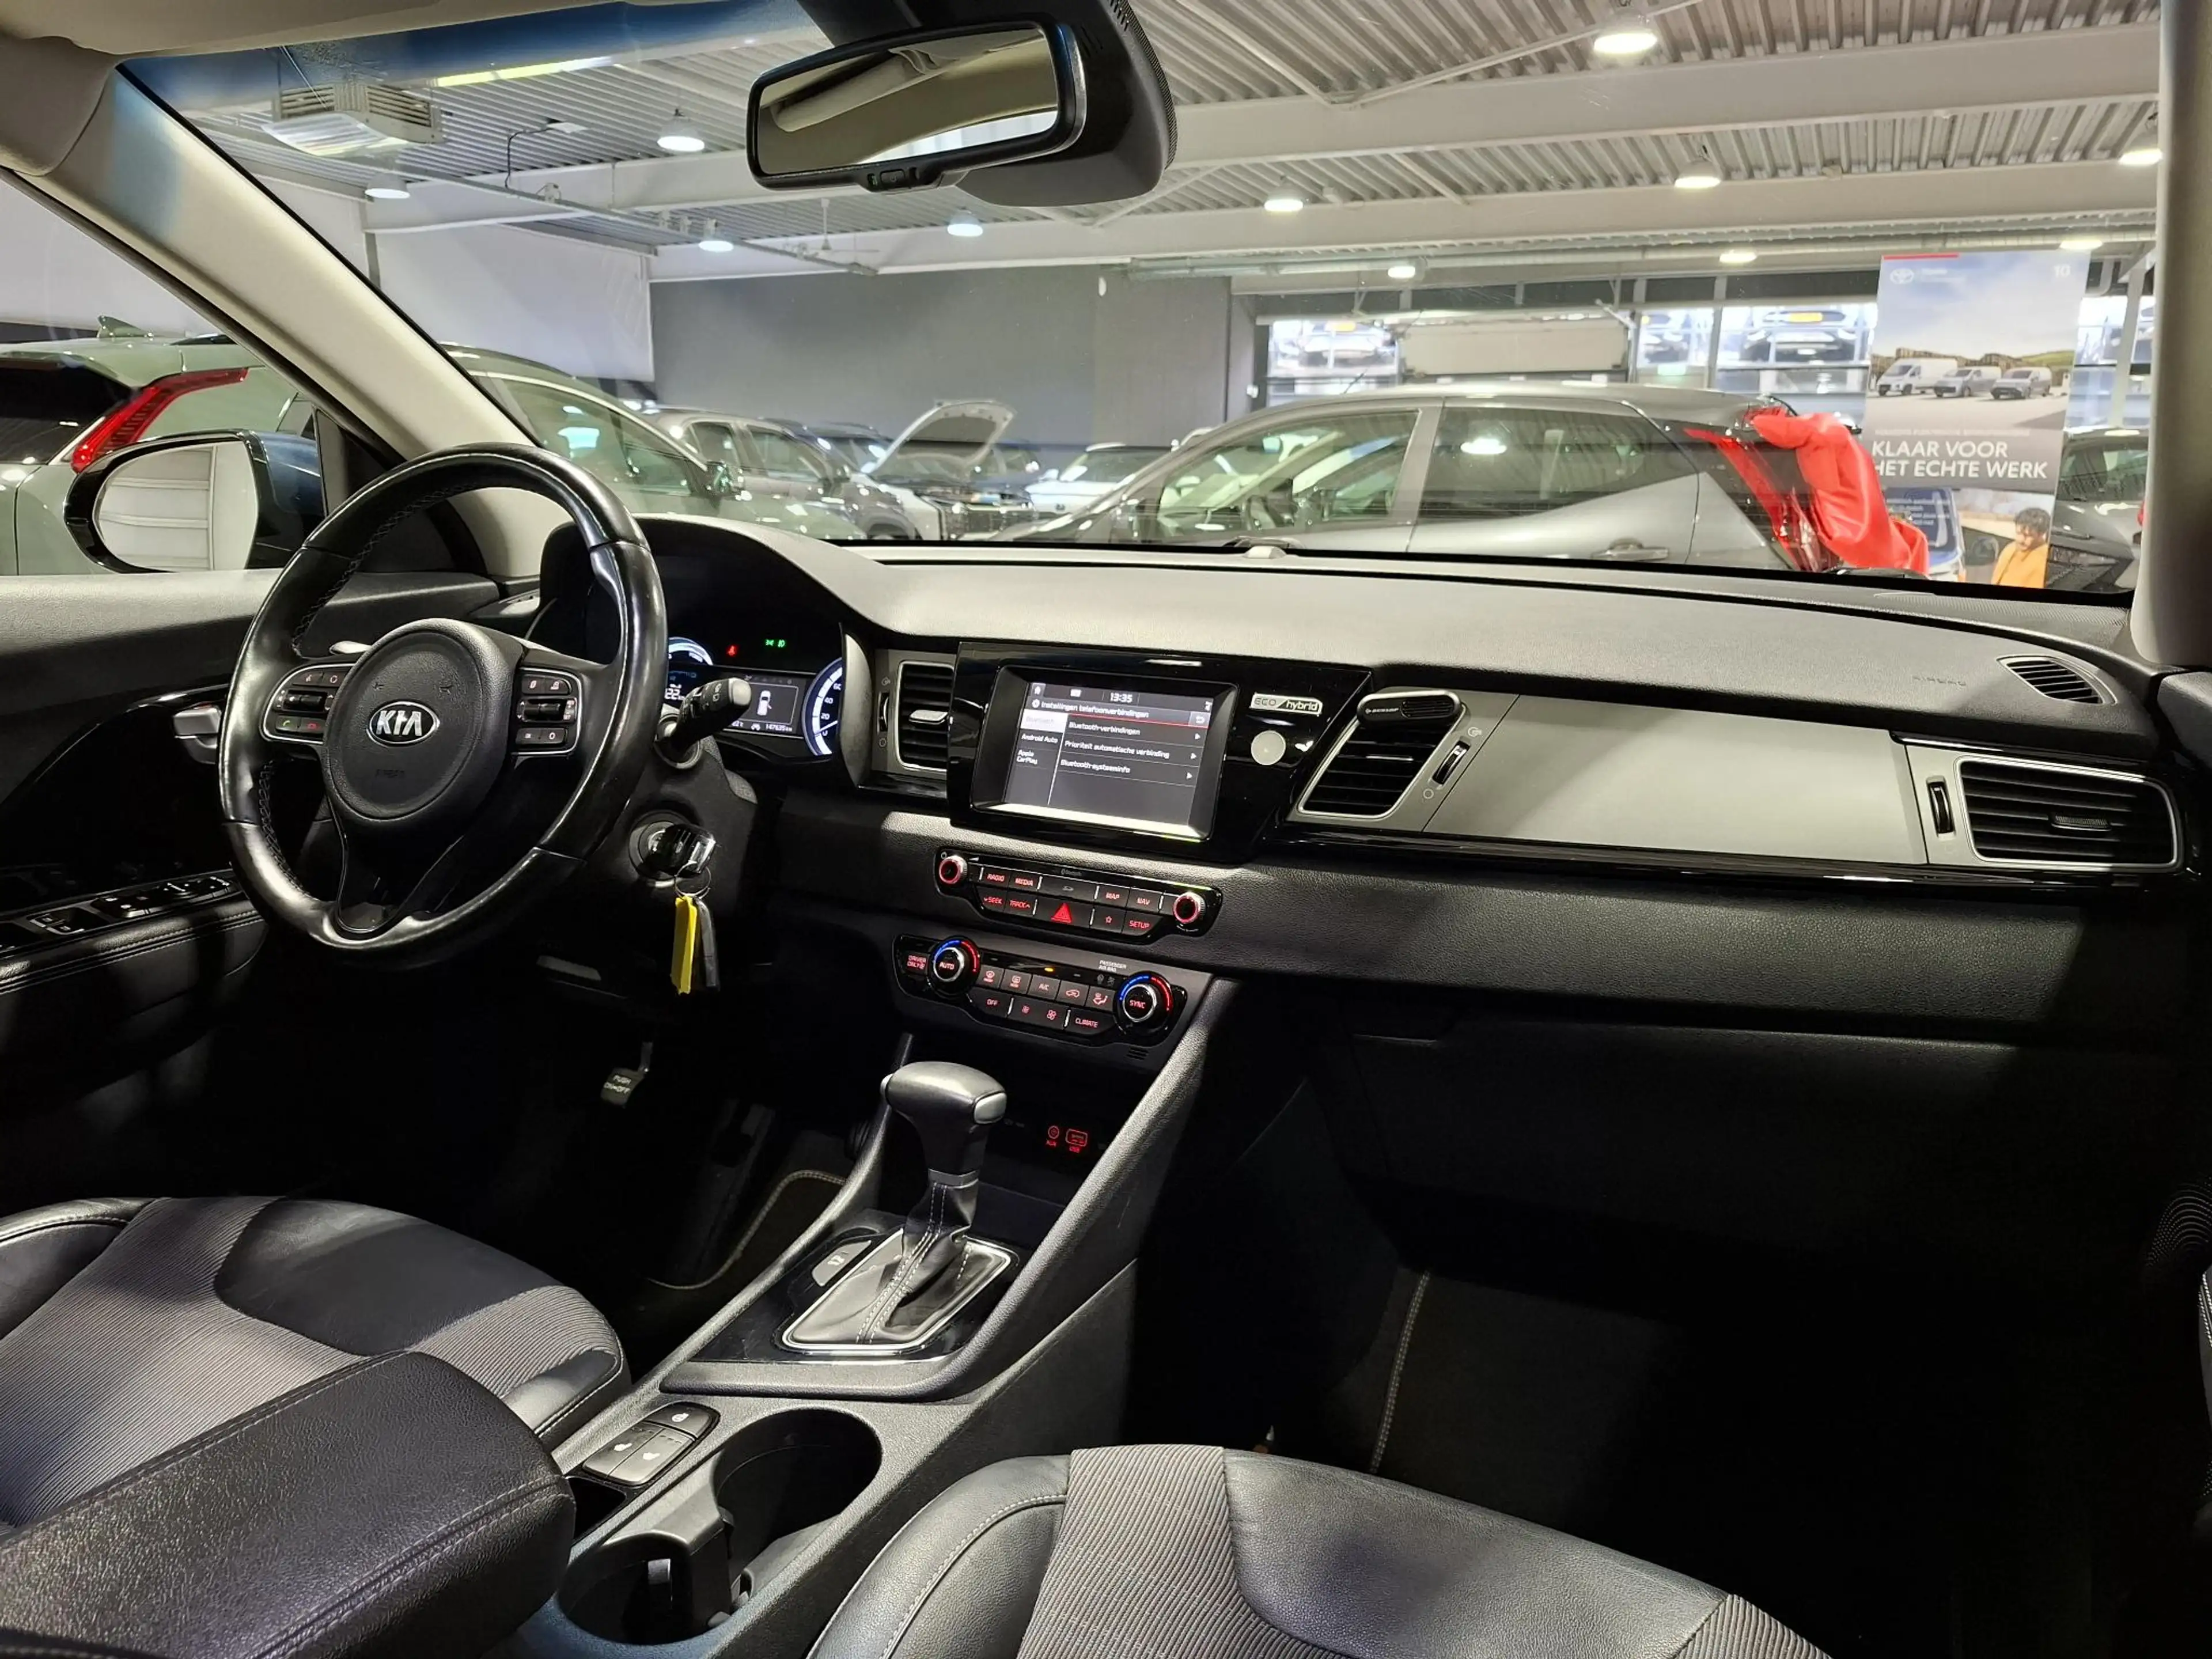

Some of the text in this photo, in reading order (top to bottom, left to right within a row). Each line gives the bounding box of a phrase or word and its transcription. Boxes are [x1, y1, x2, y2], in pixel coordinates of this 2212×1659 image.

[2054, 264, 2071, 278] 10
[1872, 440, 2008, 458] KLAAR VOOR
[1914, 460, 1979, 478] ECHTE
[1987, 461, 2048, 479] WERK
[1109, 692, 1133, 703] 13:35
[1041, 700, 1078, 712] Instellingen
[1286, 699, 1317, 710] hybrid
[376, 710, 422, 736] KIA
[1069, 722, 1141, 736] Bluetooth-verbindingen
[1021, 733, 1058, 744] Android Auto
[1017, 749, 1034, 757] Apple
[1065, 740, 1170, 759] Prioriteit automatische verbinding
[1016, 755, 1037, 765] CarPlay
[987, 873, 1005, 882] RADIO
[1015, 877, 1033, 887] MEDIA
[988, 896, 1003, 904] SEEK
[1137, 897, 1150, 906] NAV
[1129, 920, 1150, 929] SETUP
[940, 962, 955, 970] AUTO
[1099, 960, 1127, 969] PASSENGER
[1129, 999, 1146, 1009] SYNC
[1075, 1017, 1099, 1028] CLIMATE
